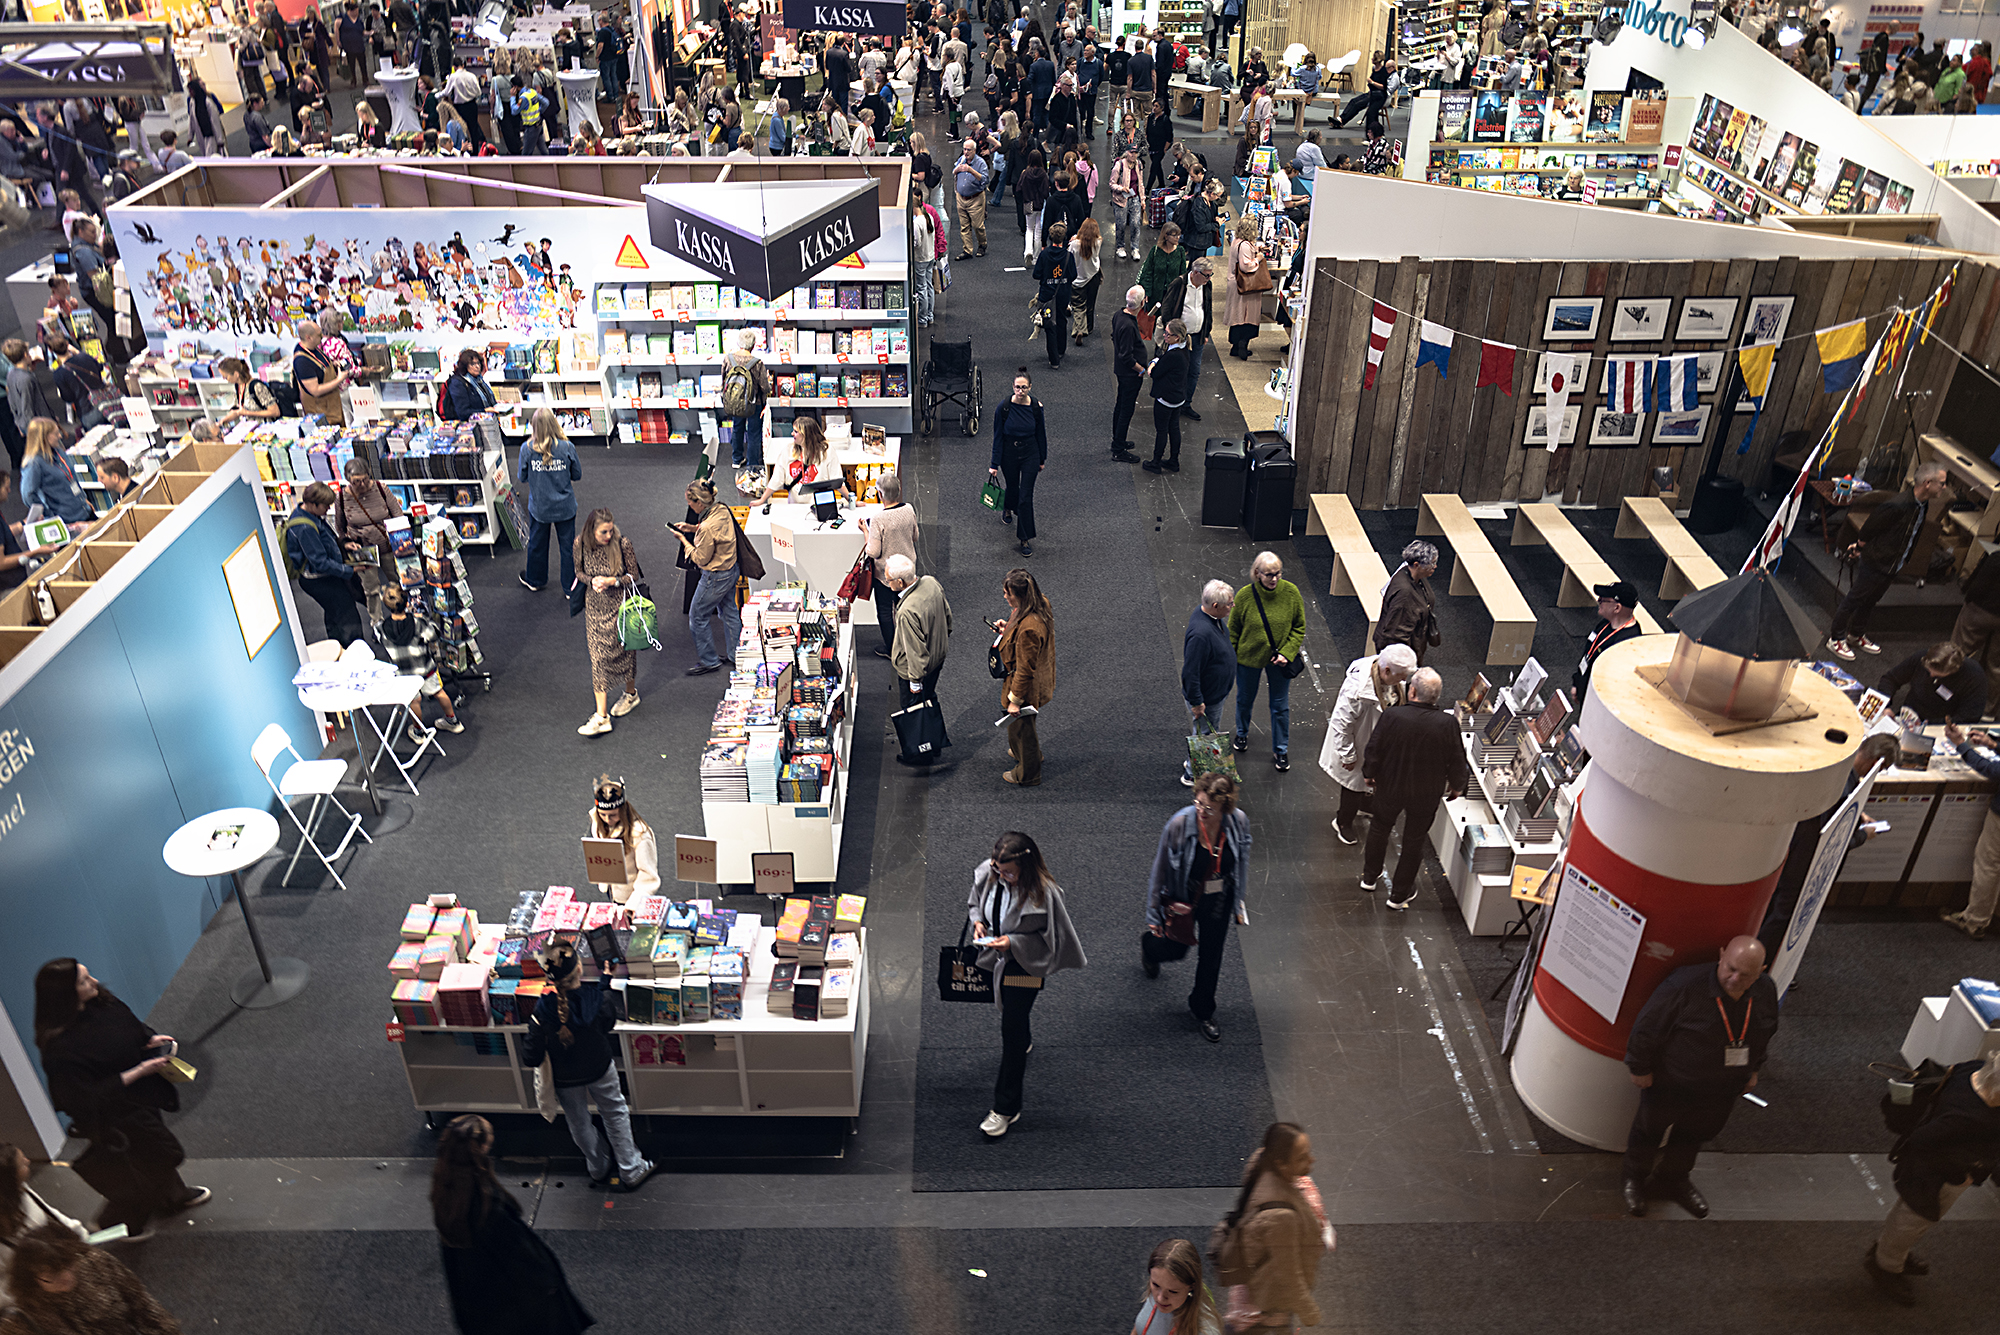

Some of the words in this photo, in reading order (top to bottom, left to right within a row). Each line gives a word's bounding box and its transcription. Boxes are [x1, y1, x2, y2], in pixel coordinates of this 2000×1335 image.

[814, 5, 875, 28] KASSA
[1474, 123, 1505, 132] Fallström
[674, 218, 736, 275] KASSA
[799, 215, 855, 273] KASSA
[773, 536, 794, 548] 149:-
[588, 857, 624, 867] 189:-
[679, 853, 715, 865] 199:-
[756, 868, 792, 878] 169:-
[951, 981, 965, 992] till
[968, 983, 990, 992] fler.
